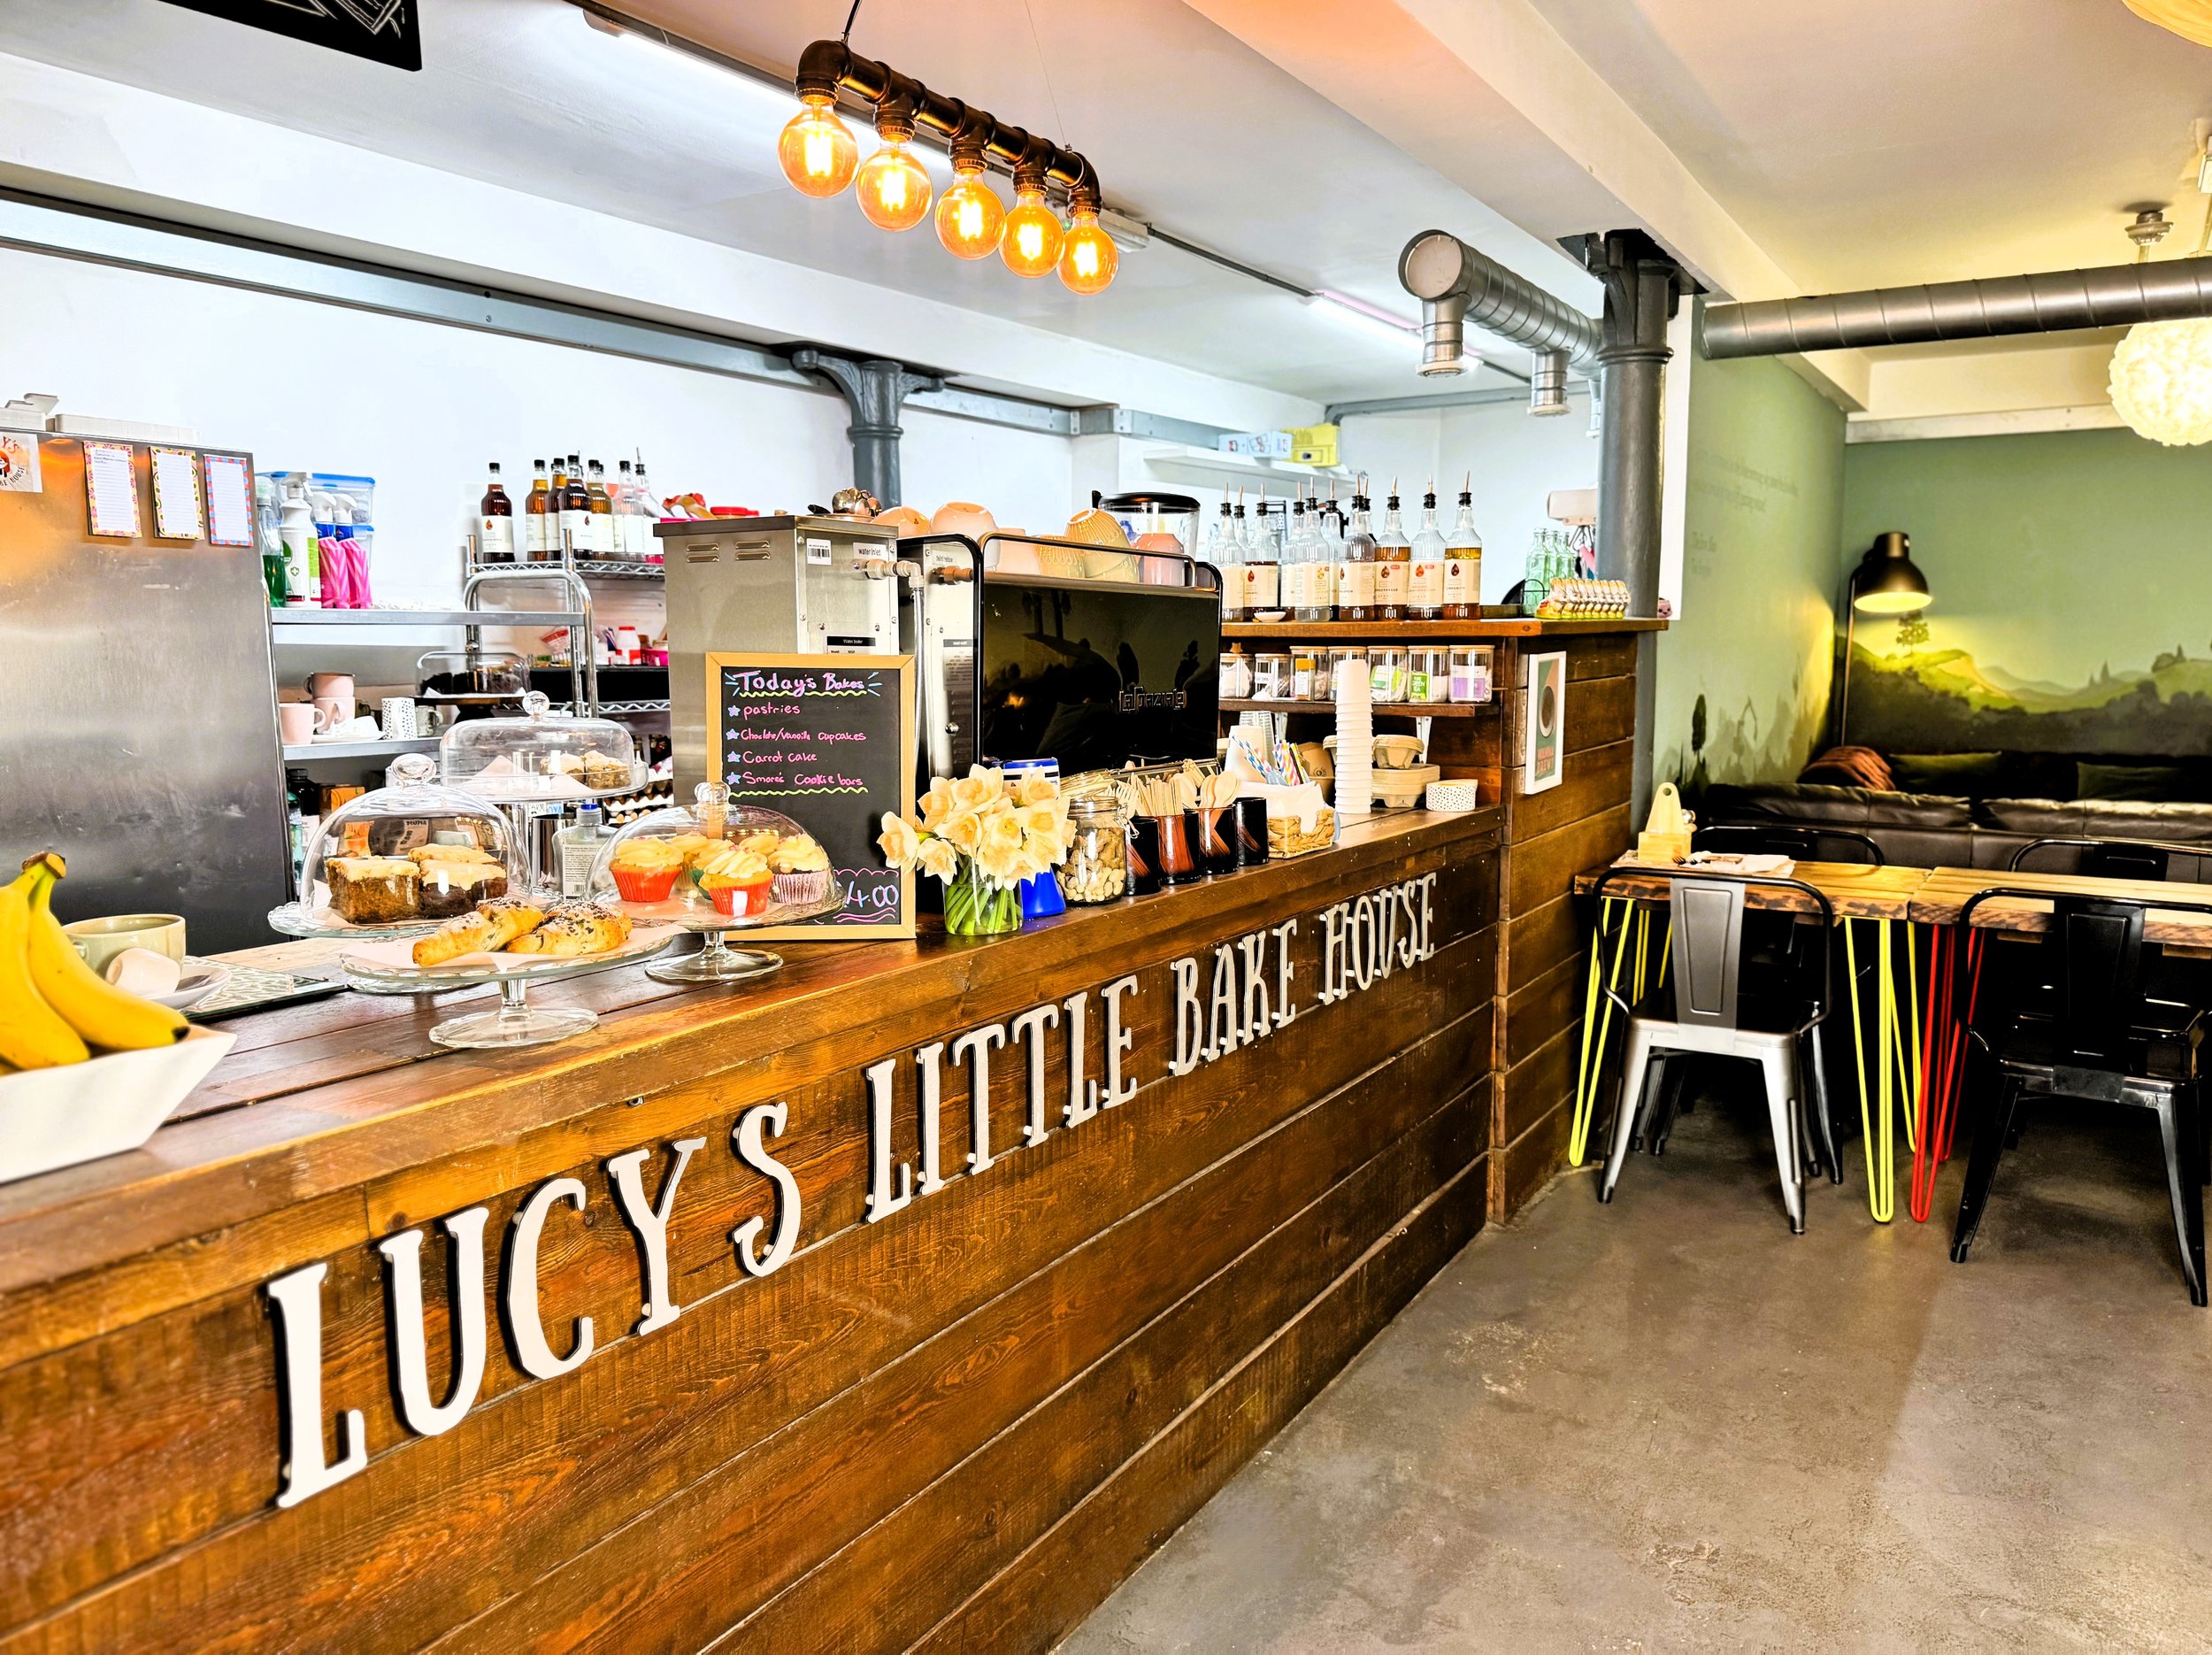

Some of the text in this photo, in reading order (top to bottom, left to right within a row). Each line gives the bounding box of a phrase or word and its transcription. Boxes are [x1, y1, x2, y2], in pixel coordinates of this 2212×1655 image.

[733, 670, 865, 698] Today's Bakes
[743, 702, 801, 720] pastries
[818, 731, 867, 744] cupcakes
[742, 751, 783, 765] Carrot
[840, 774, 864, 786] bars
[865, 974, 1139, 1224] LITTLE
[1169, 917, 1298, 1077] BAKE
[1317, 872, 1437, 1005] HOUSE
